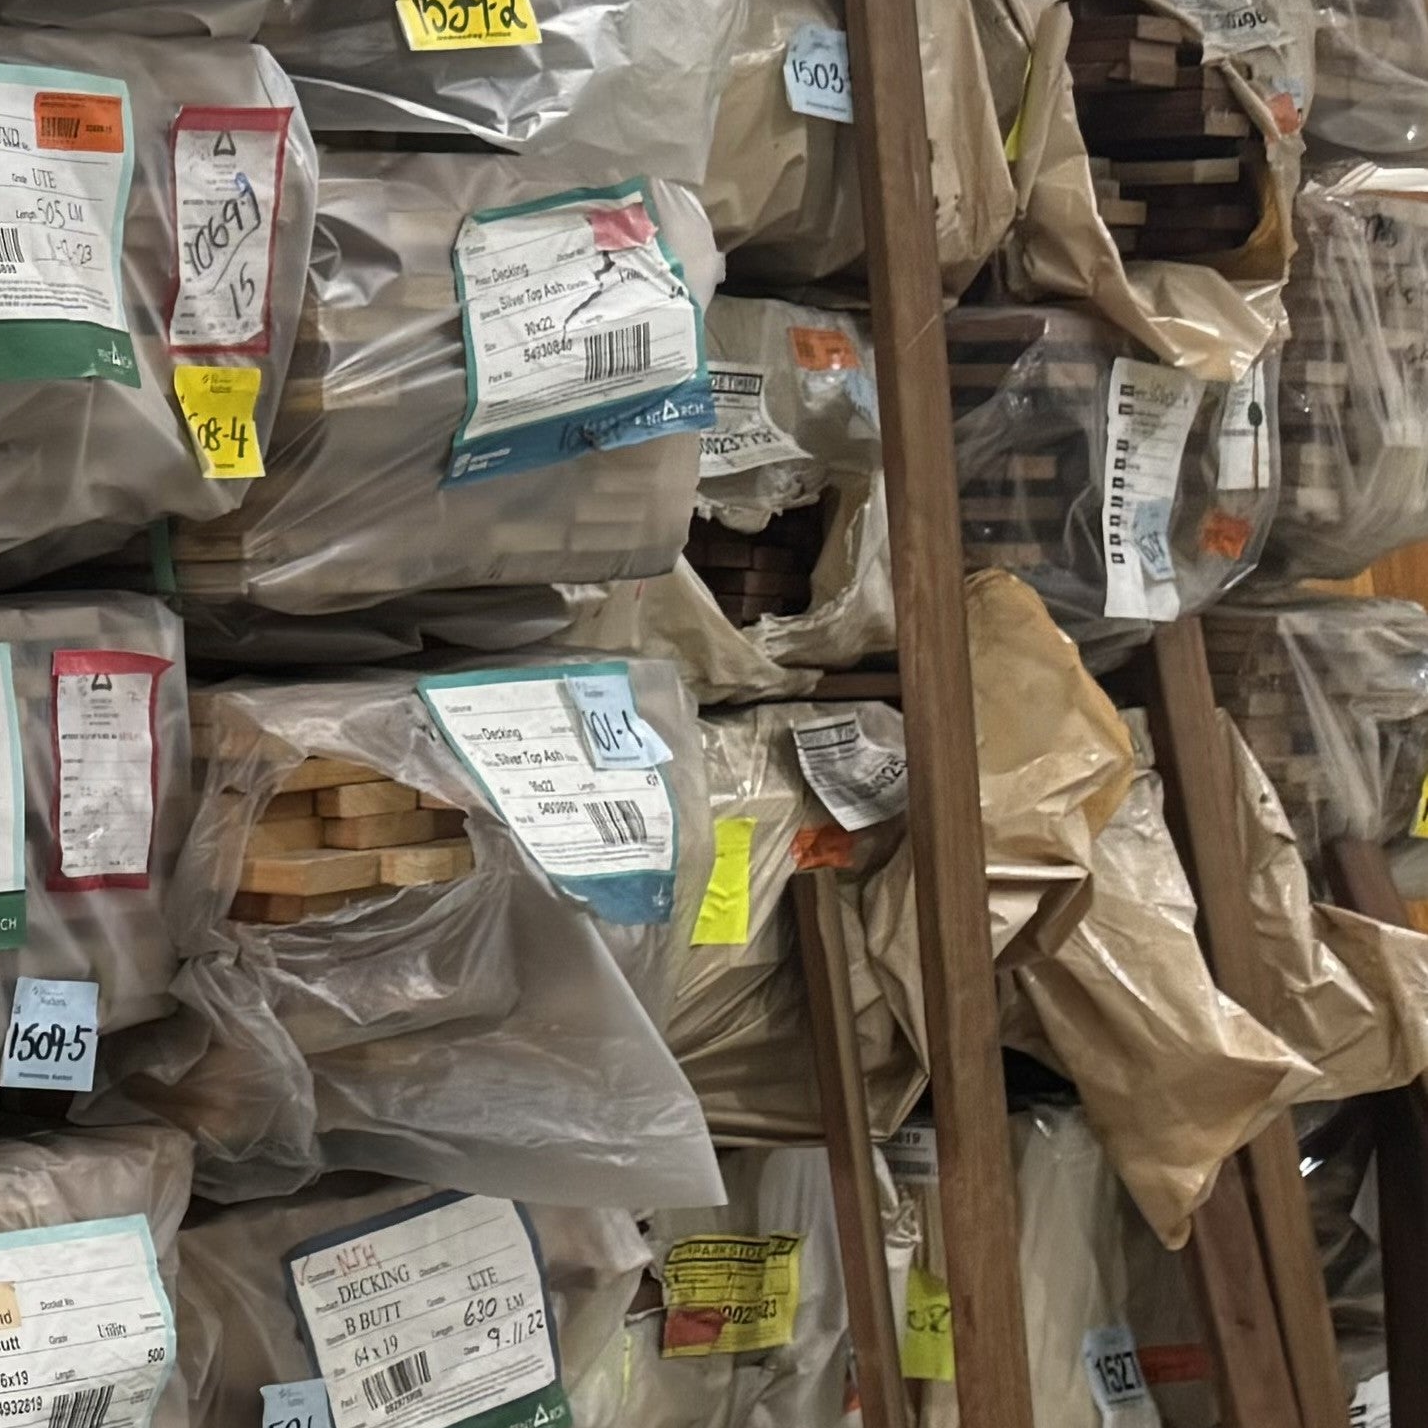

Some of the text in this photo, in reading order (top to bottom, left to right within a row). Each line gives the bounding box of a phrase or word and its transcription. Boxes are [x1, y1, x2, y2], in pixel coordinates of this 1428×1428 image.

[32, 168, 57, 189] UTE
[491, 262, 528, 283] Decking
[499, 291, 525, 311] Silver
[544, 280, 565, 299] Ash
[482, 727, 523, 741] Decking
[501, 748, 564, 766] Silver Top Ash
[8, 1023, 93, 1061] 1509-5
[338, 1263, 410, 1306] DECKING
[345, 1300, 403, 1336] B BUTT
[463, 1297, 497, 1328] 630
[147, 1347, 166, 1364] 500
